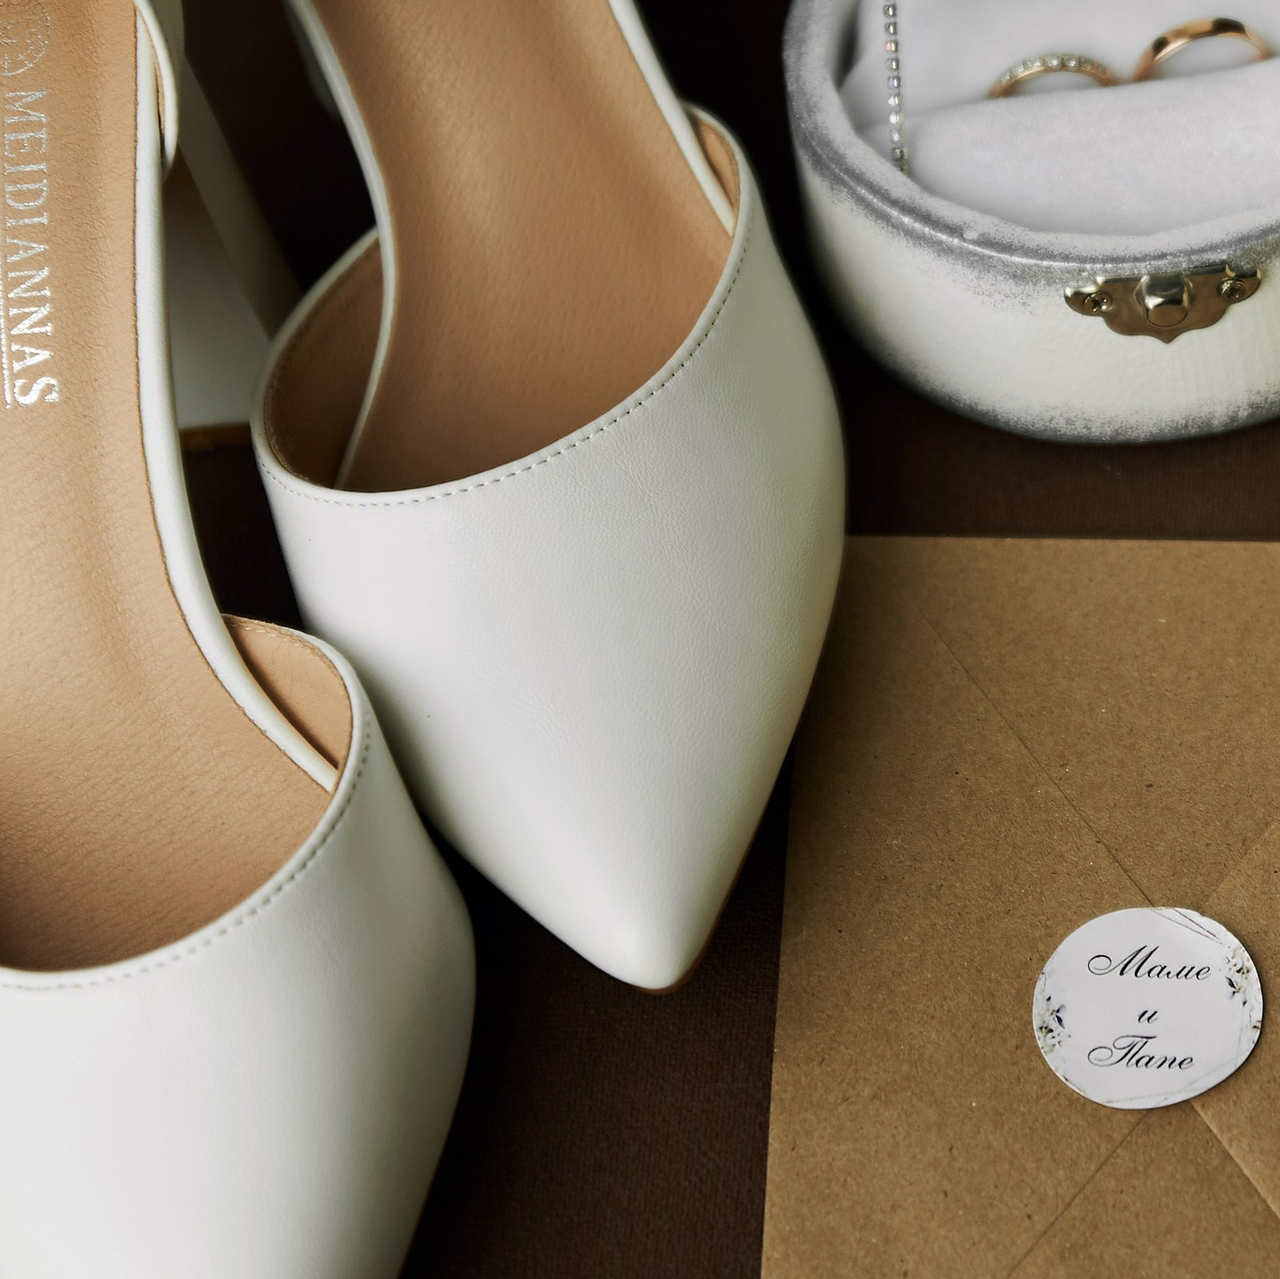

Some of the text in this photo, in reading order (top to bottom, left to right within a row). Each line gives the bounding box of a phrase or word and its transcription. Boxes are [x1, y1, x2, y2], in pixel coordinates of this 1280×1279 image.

[2, 88, 60, 406] MEIDIANNAS
[1086, 944, 1213, 981] Маме
[1137, 1008, 1160, 1024] и
[1086, 1034, 1195, 1071] Папе
